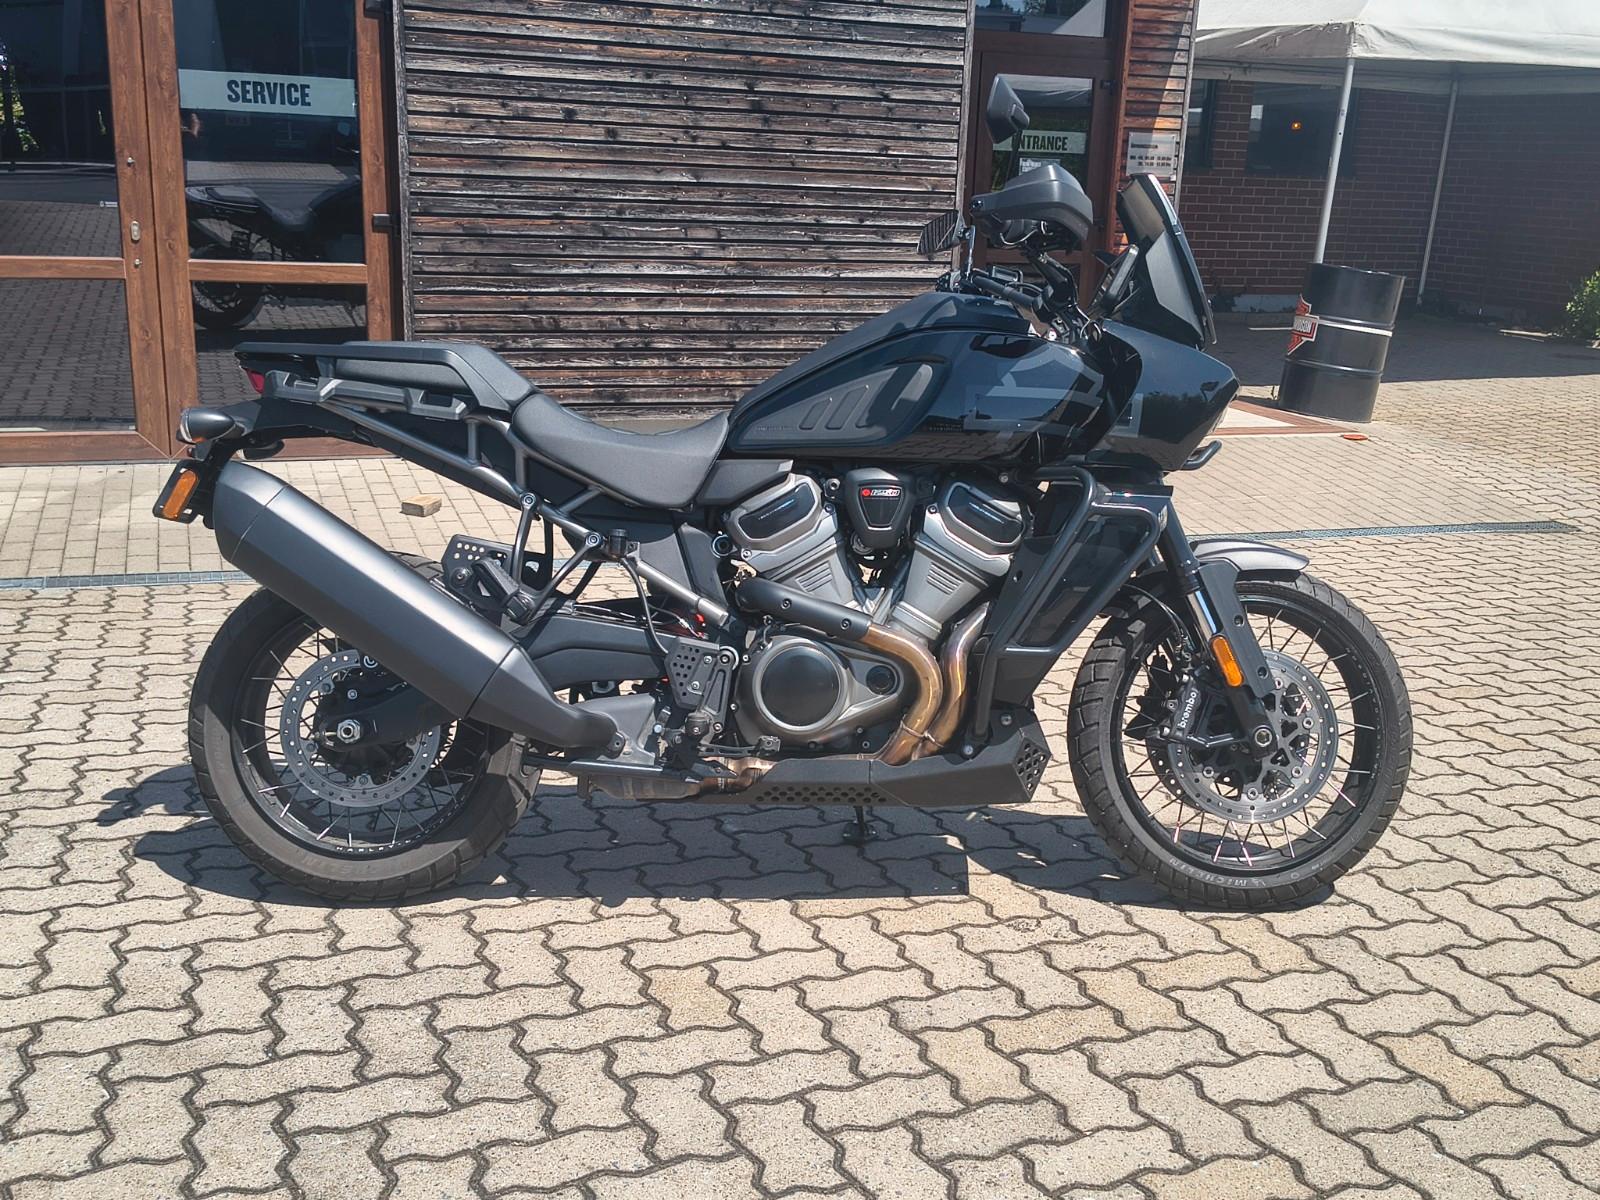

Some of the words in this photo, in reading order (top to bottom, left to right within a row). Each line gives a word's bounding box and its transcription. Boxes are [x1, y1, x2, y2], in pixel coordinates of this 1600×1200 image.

[226, 79, 312, 107] SERVICE
[1018, 134, 1069, 152] NTRANCE
[1177, 691, 1198, 728] brembo
[1169, 857, 1248, 888] MICHELIN
